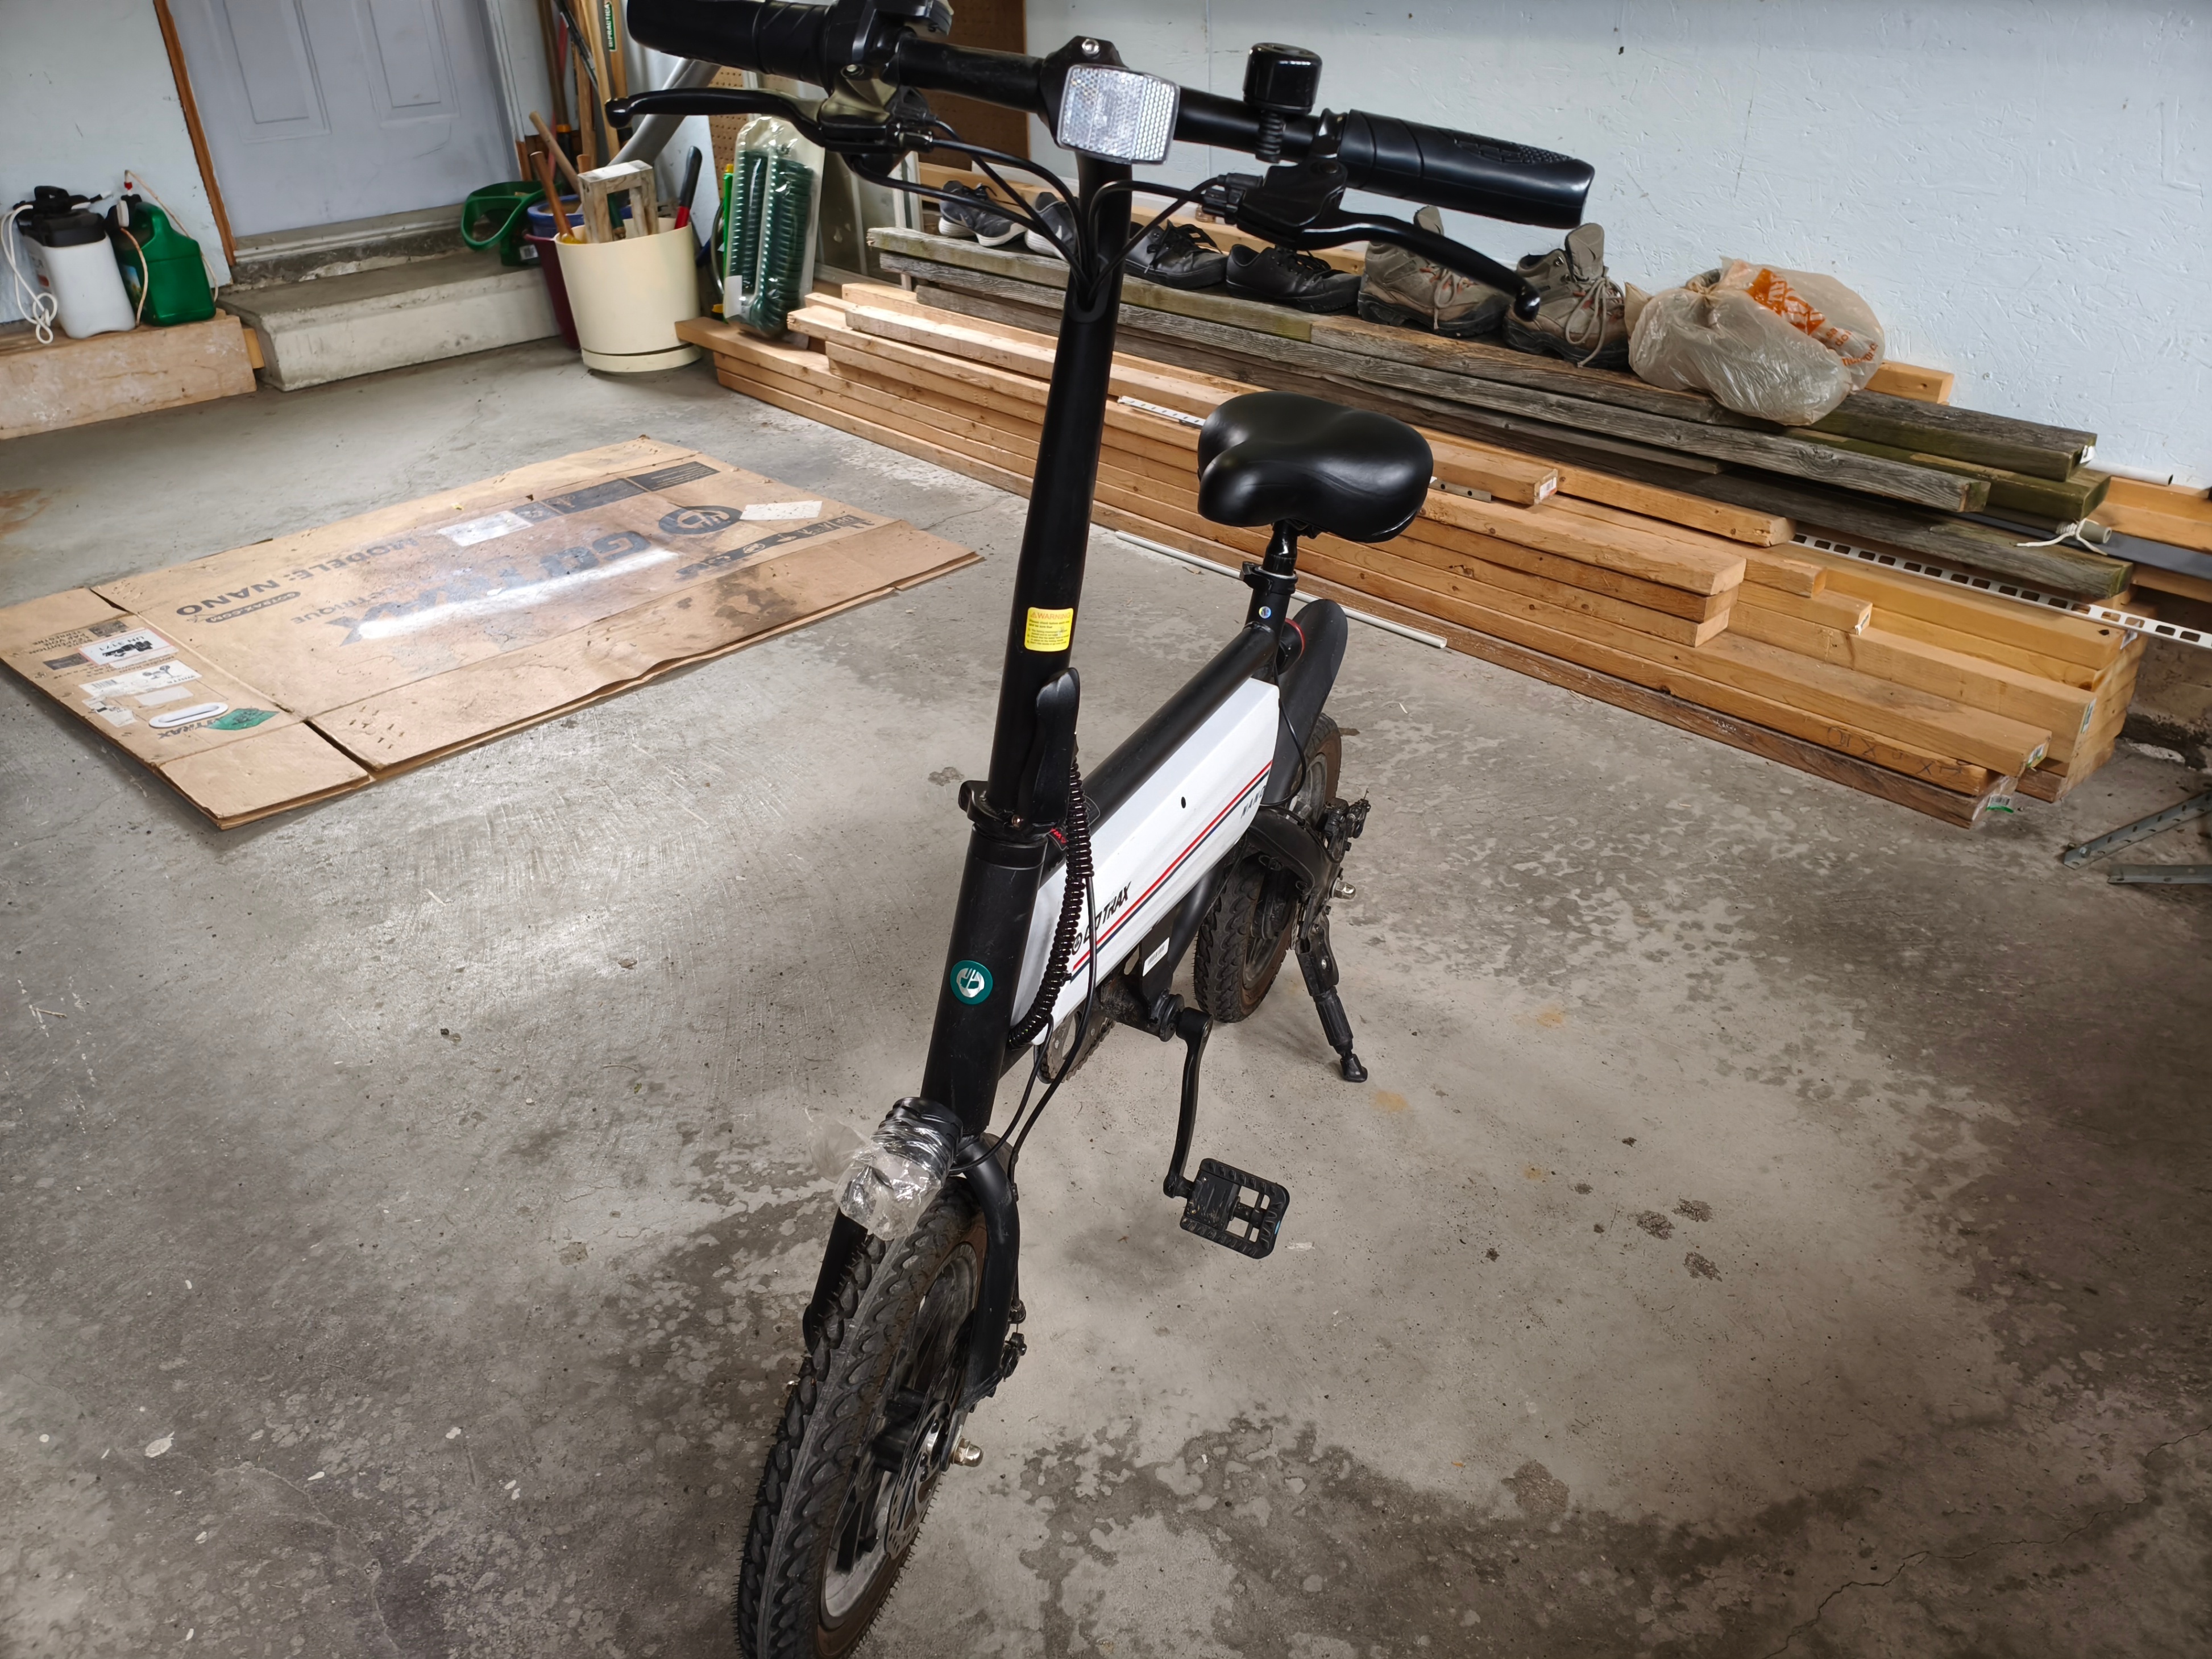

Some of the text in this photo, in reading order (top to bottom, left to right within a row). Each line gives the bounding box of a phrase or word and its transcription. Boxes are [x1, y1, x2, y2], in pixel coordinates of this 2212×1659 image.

[176, 579, 280, 616] NANO
[208, 592, 296, 622] GOTRAX.COM
[157, 718, 219, 739] TRAX
